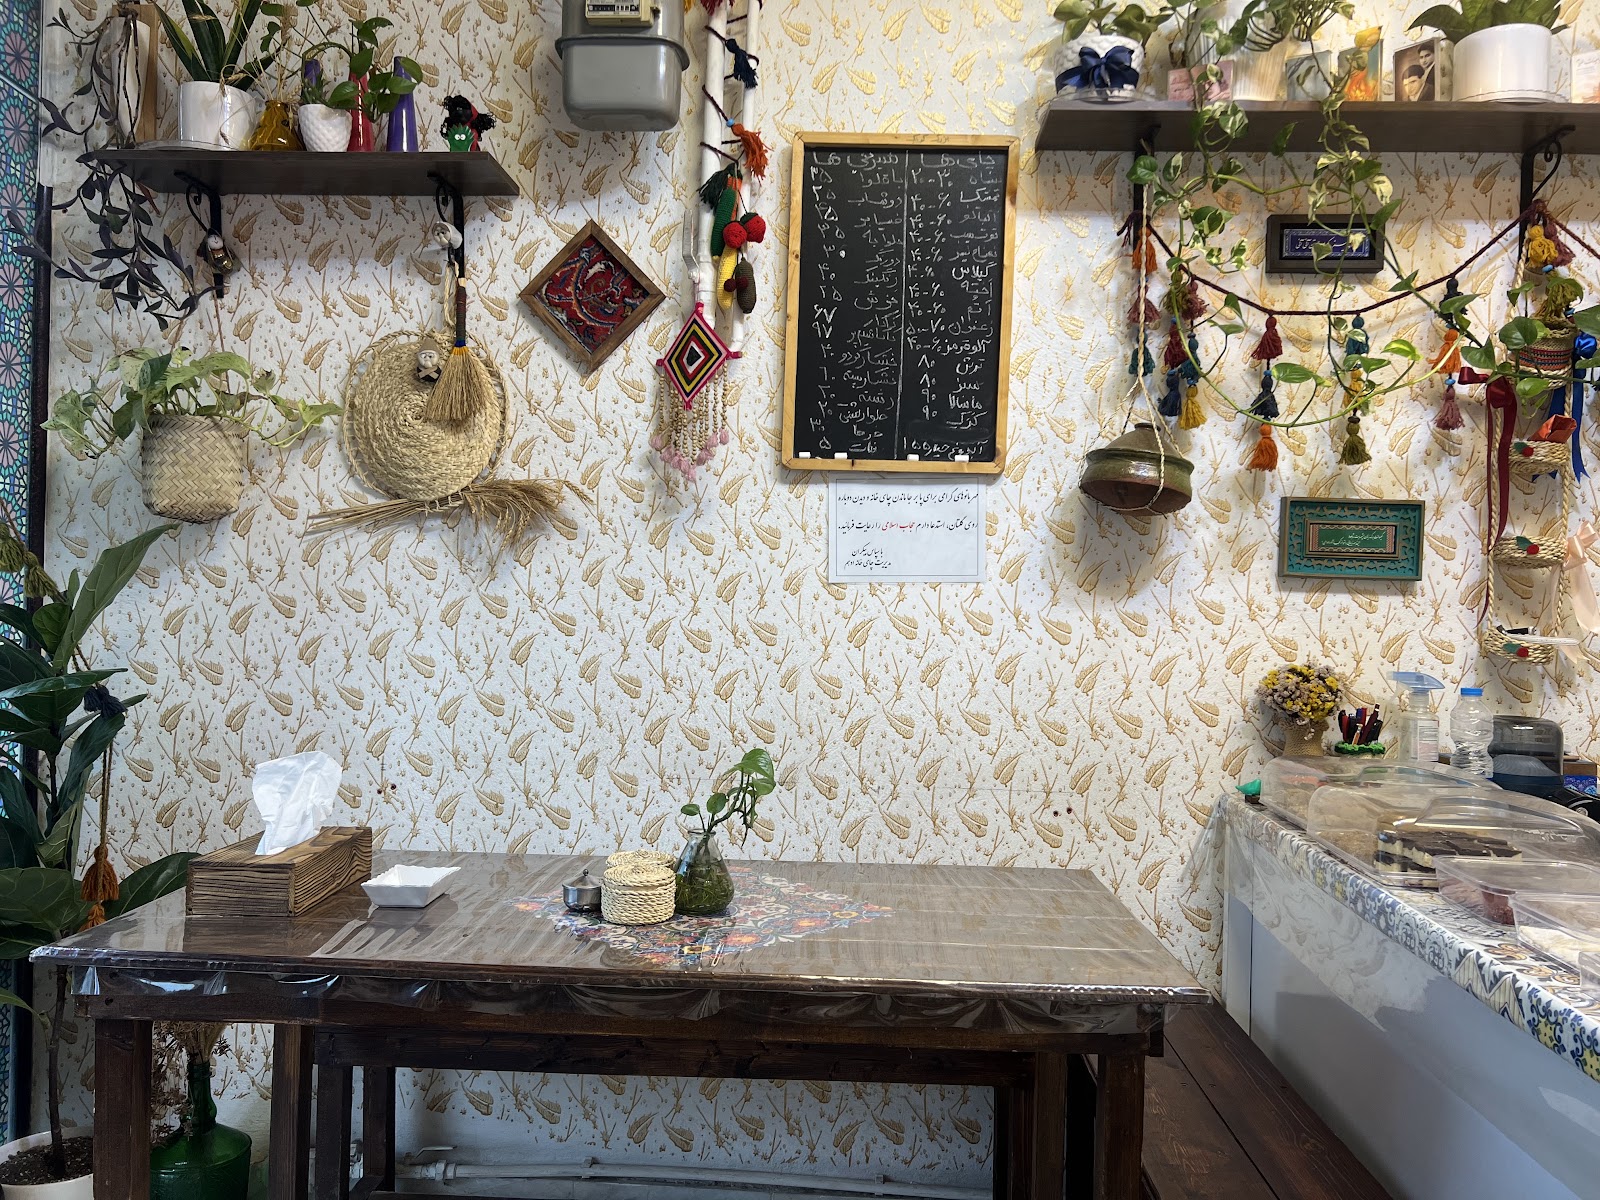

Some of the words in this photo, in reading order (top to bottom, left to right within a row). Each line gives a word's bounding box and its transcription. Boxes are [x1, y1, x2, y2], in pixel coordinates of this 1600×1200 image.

[813, 152, 841, 166] ها
[920, 153, 956, 168] ها
[860, 168, 904, 189] باقلوا
[952, 261, 998, 282] گیلاس
[813, 304, 838, 324] ۶۷
[811, 321, 833, 338] ۹۷
[819, 435, 832, 450] ۵
[838, 493, 852, 505] دوباره
[852, 495, 865, 505] دیدن
[879, 493, 891, 506] چای
[923, 493, 937, 504] برای
[938, 487, 959, 502] گرامی
[856, 522, 875, 532] رعایت
[882, 521, 898, 531] اسلامی
[899, 521, 915, 532] حجاب
[964, 521, 978, 531] روی
